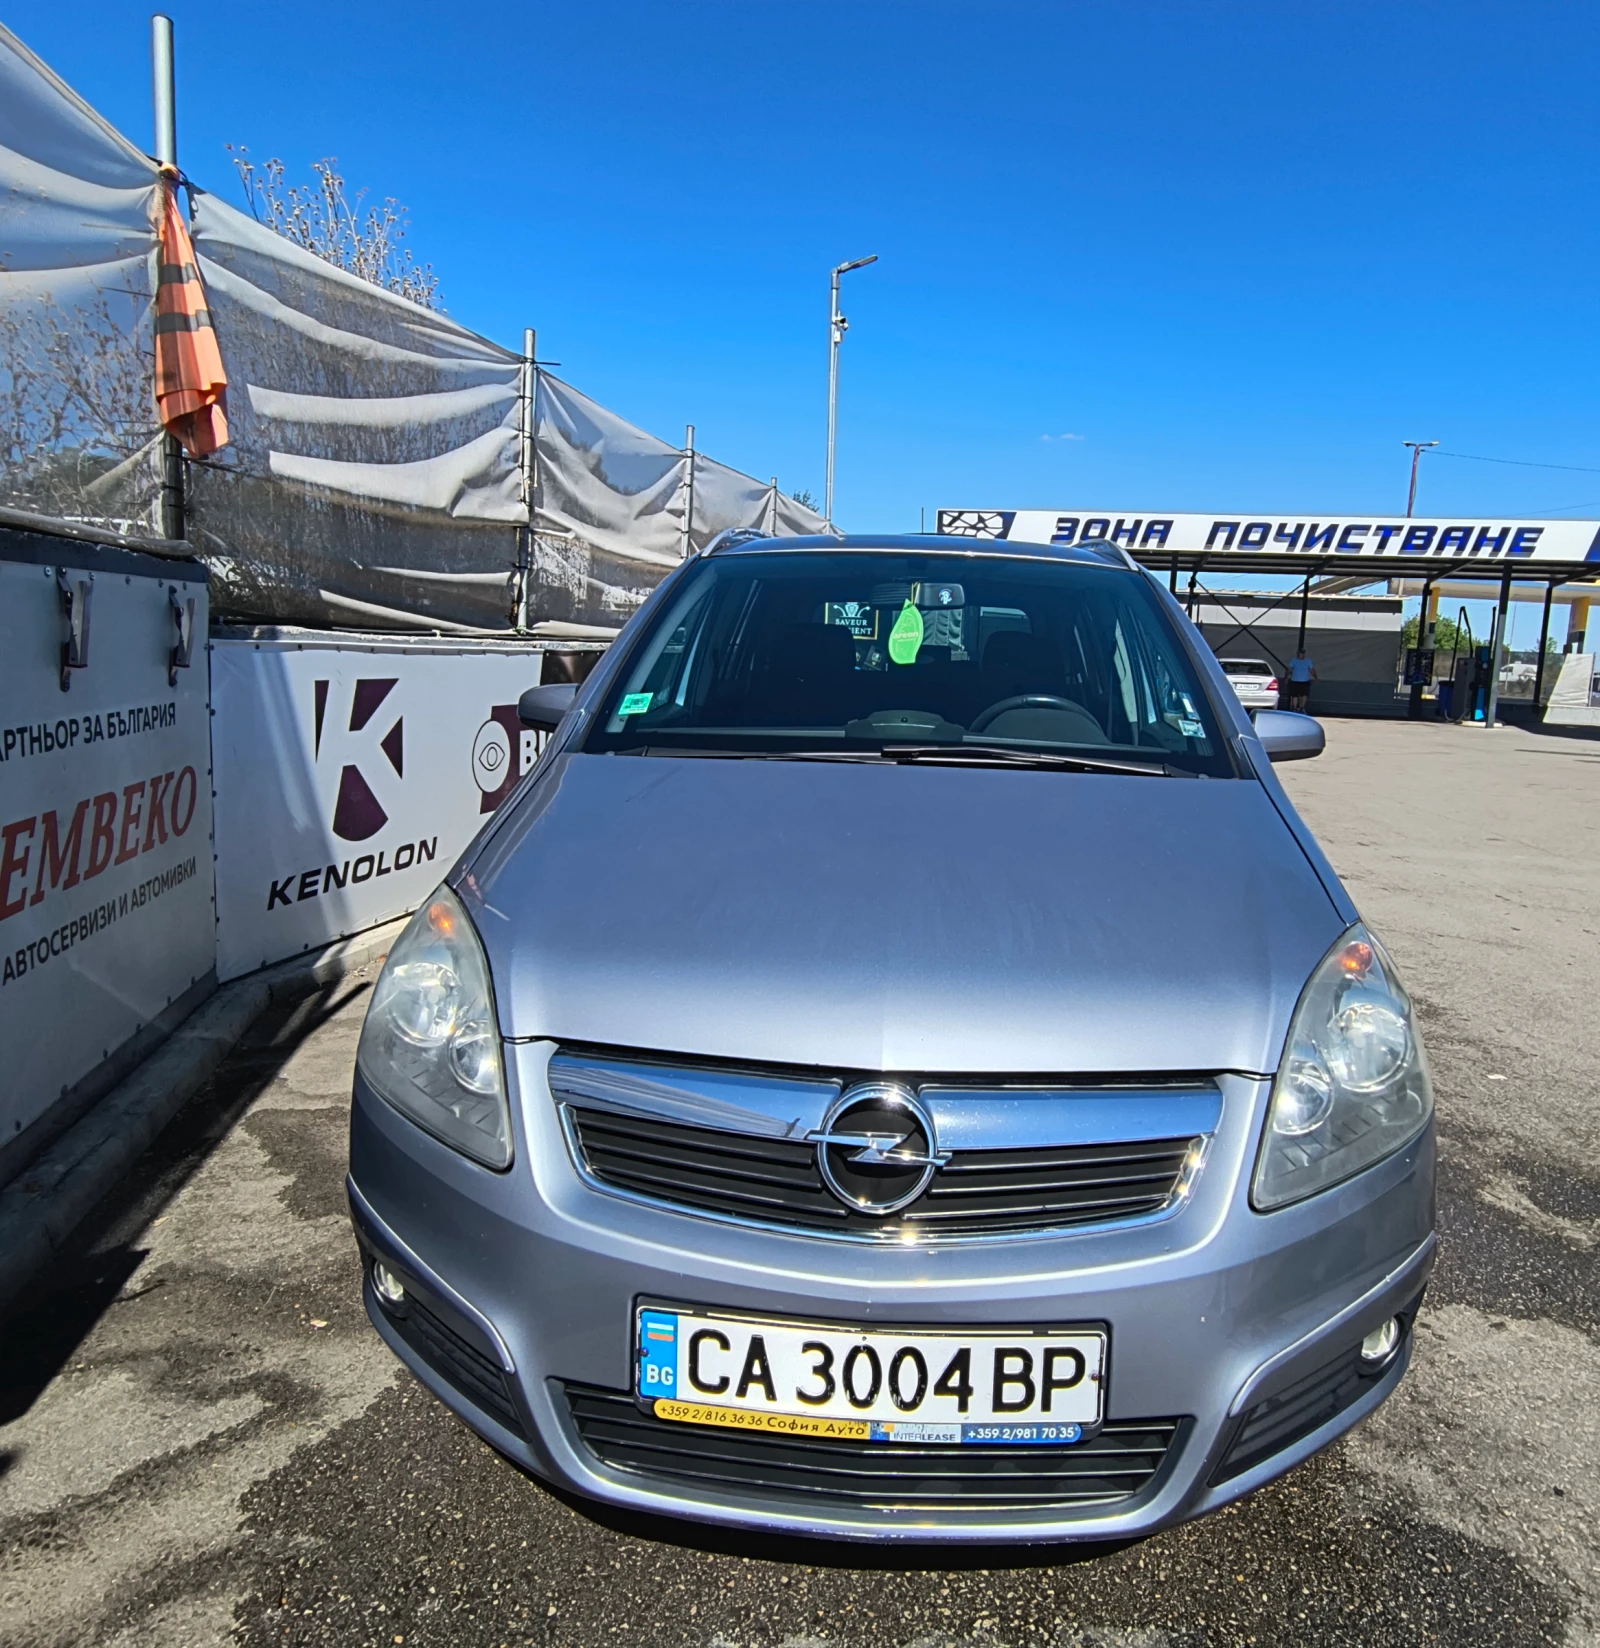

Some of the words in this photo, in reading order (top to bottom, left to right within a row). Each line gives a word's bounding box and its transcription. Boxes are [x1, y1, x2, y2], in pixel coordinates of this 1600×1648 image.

[1050, 517, 1175, 548] ЗОНА
[1204, 520, 1545, 558] ПОЧИСТВАНЕ
[835, 618, 868, 626] SAVEUR
[849, 627, 873, 635] IENT
[0, 718, 80, 762] РТНЬОР
[83, 714, 105, 744] ЗА
[107, 702, 176, 739] БЪЛГАРИЯ
[267, 836, 438, 911] KENOLON
[2, 899, 117, 986] АВТОСЕРВИЗИ
[119, 893, 128, 918] И
[131, 856, 197, 912] АВТОМИВКИ
[646, 1363, 674, 1386] BG
[688, 1328, 777, 1402] CA
[796, 1341, 974, 1412] 3004
[992, 1346, 1086, 1413] BP
[660, 1405, 690, 1418] +359
[692, 1408, 727, 1422] 2/816
[730, 1413, 745, 1424] 36
[748, 1415, 762, 1426] 36
[767, 1416, 819, 1432] София
[825, 1423, 865, 1436] Ауто
[893, 1430, 957, 1442] INTERLEASE
[968, 1428, 1000, 1439] +359
[1002, 1428, 1037, 1440] 2/981
[1042, 1427, 1056, 1439] 70
[1059, 1426, 1074, 1438] 35
